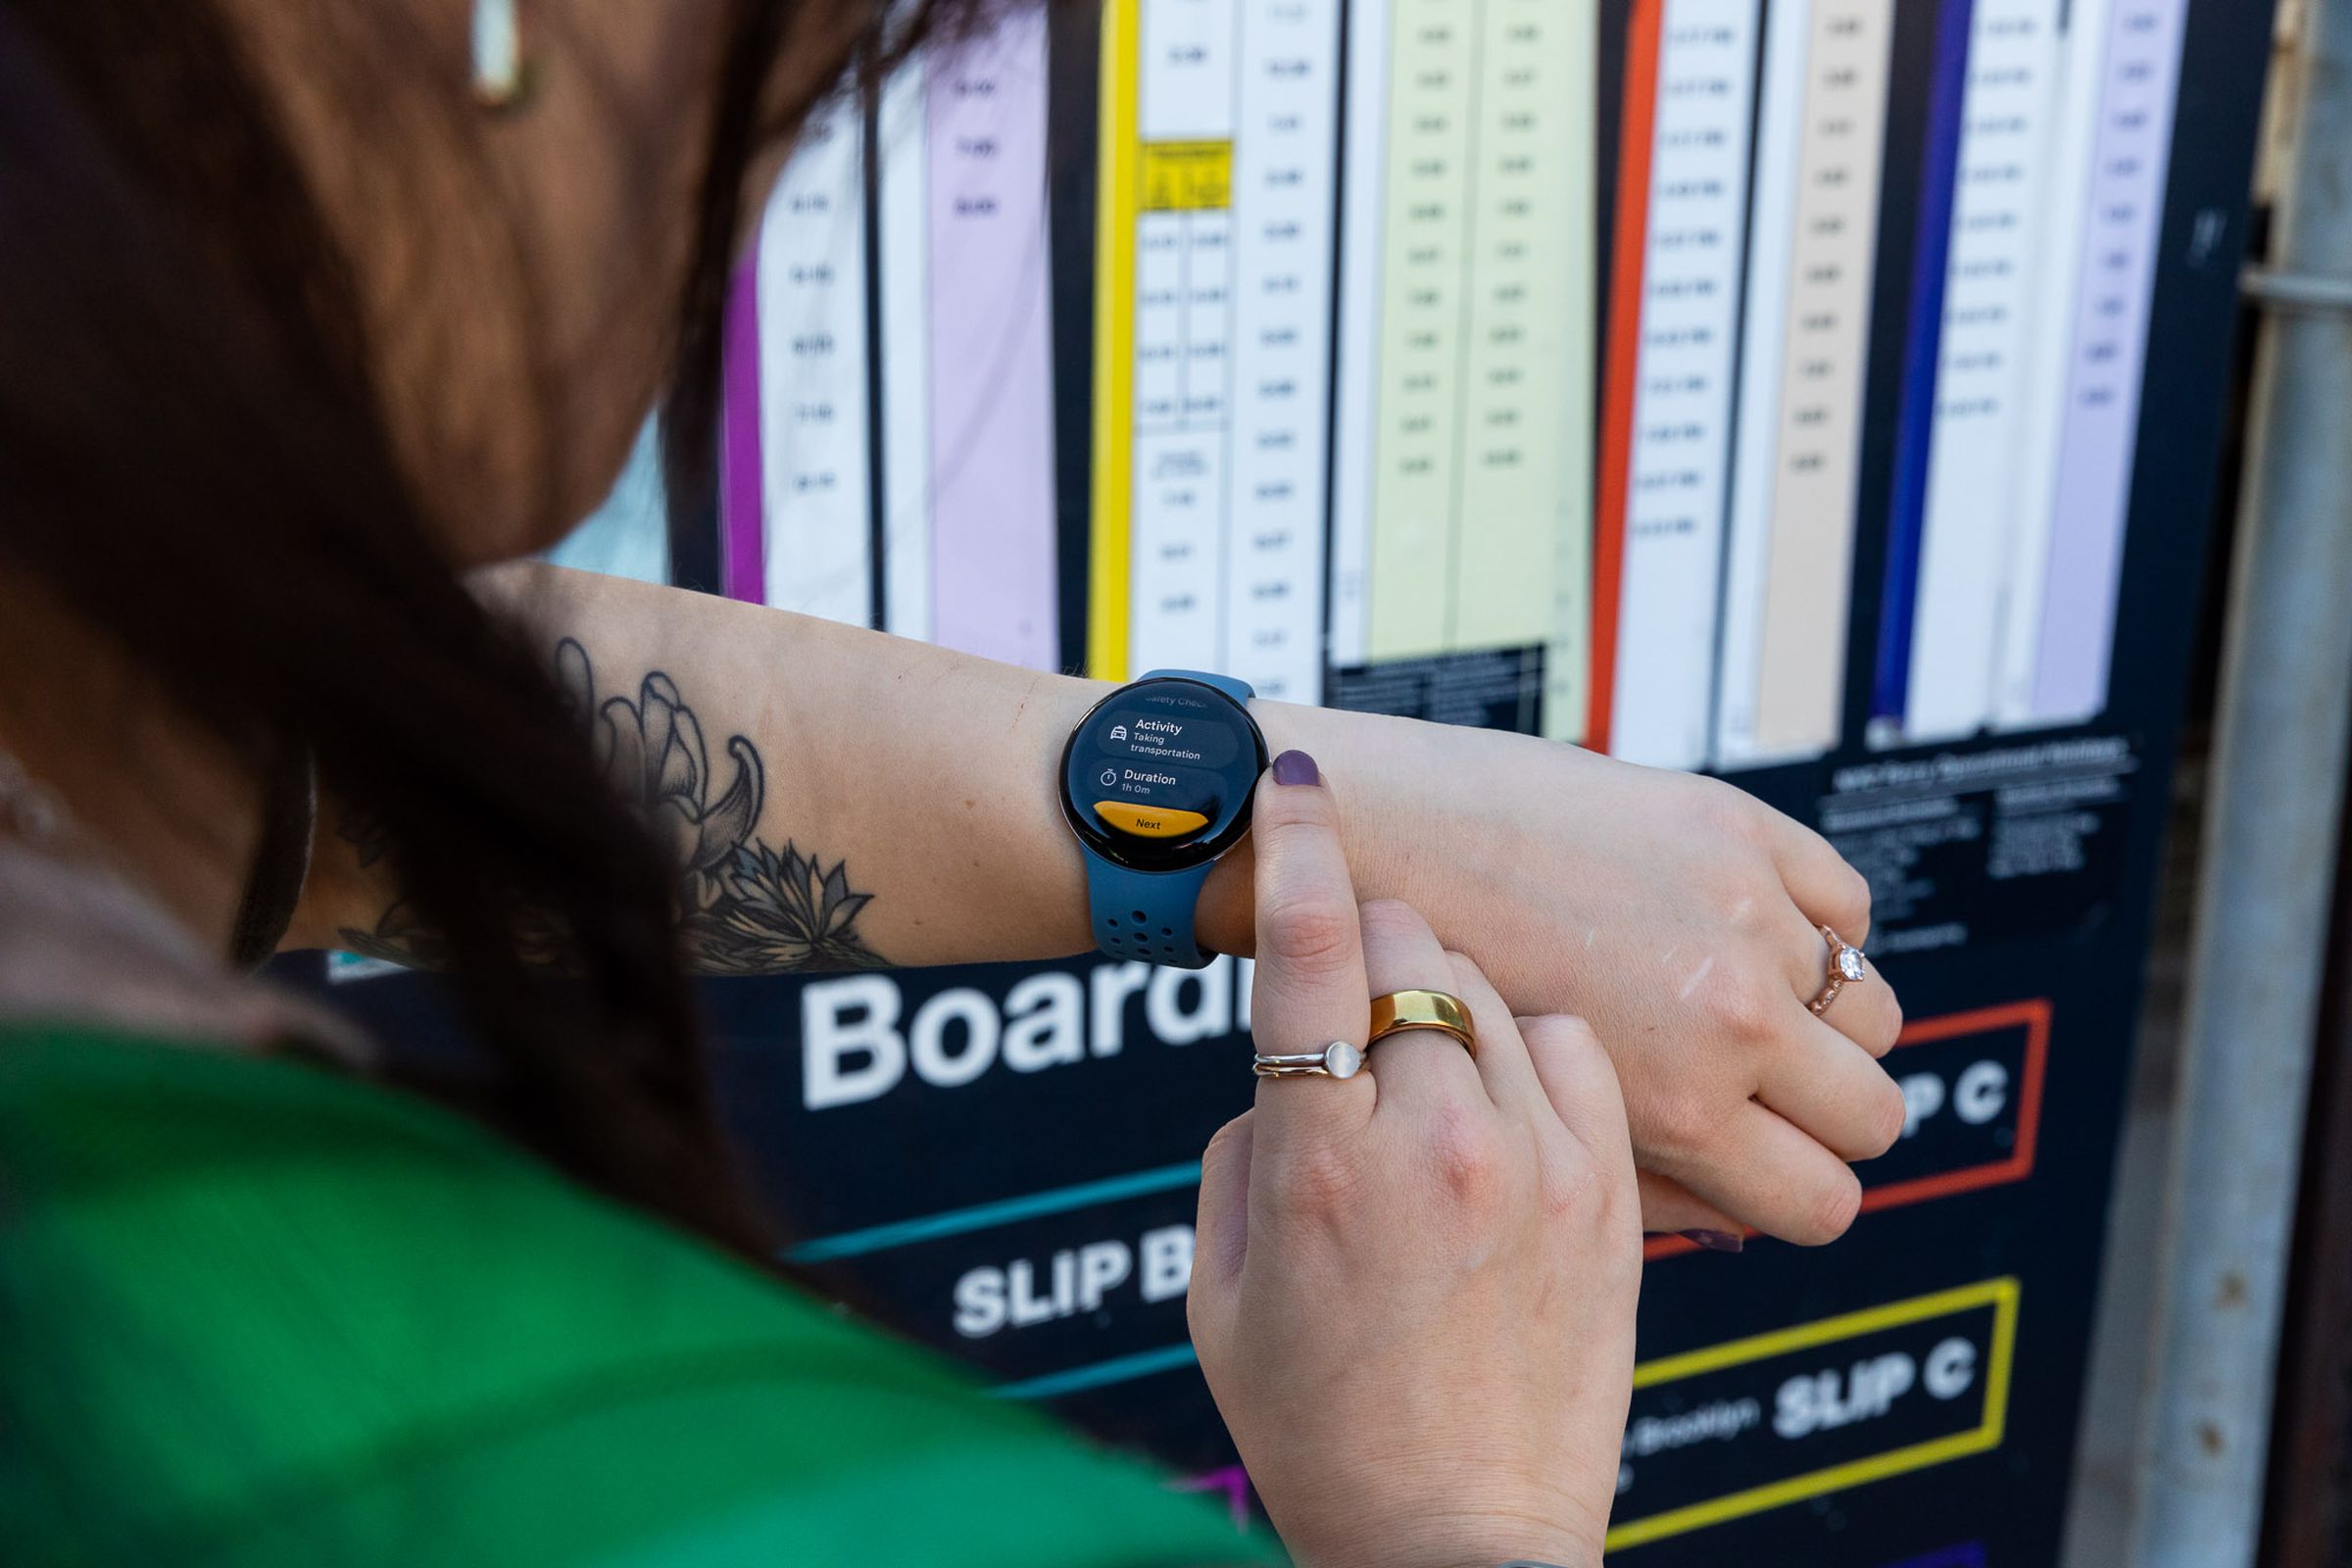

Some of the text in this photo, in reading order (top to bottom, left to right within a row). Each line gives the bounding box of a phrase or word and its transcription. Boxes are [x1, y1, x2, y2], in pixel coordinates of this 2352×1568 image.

[1135, 718, 1183, 736] Activity
[1133, 732, 1165, 746] Taking
[1130, 744, 1200, 760] transportation
[1124, 769, 1176, 786] Duration
[1122, 783, 1132, 793] 1h
[1136, 818, 1161, 830] Next
[1953, 1059, 2008, 1124] C
[953, 1239, 1133, 1340] SLIP
[1771, 1336, 1978, 1440] SLIP C
